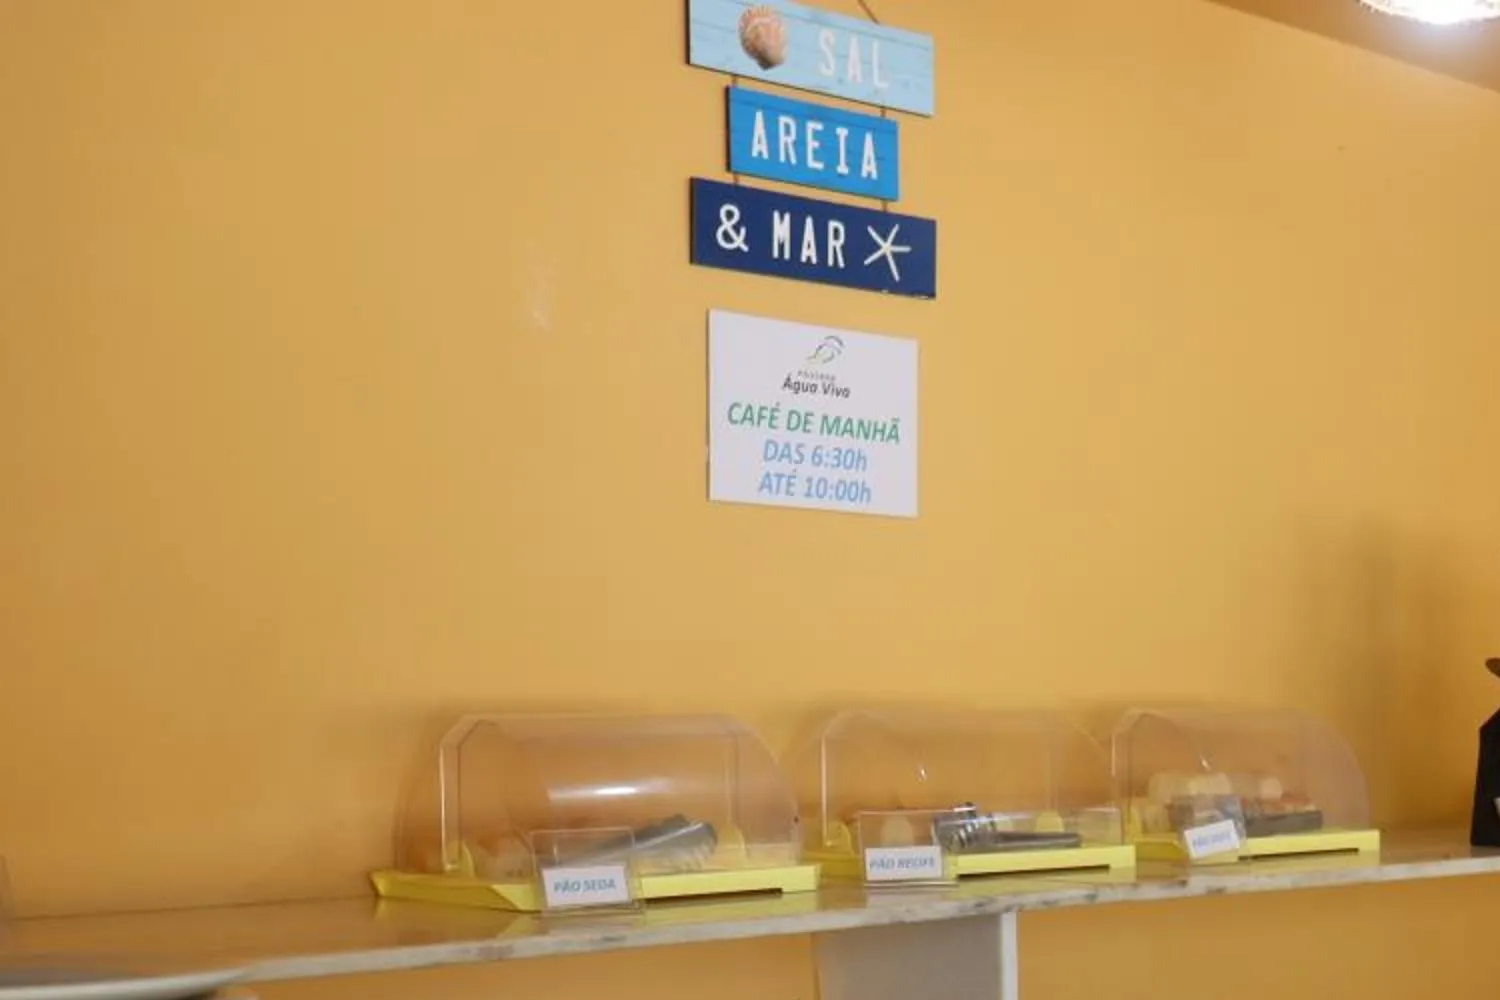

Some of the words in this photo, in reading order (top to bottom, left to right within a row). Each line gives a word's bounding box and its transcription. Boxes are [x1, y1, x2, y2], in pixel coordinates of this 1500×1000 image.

[819, 29, 889, 89] SAL
[751, 109, 878, 180] AREIA
[716, 203, 749, 252] &
[772, 209, 846, 269] MAR
[781, 372, 818, 395] Água
[822, 381, 851, 399] Viva
[727, 401, 781, 430] CAFÉ
[786, 409, 815, 434] DE
[820, 414, 901, 443] MANHÃ
[763, 439, 805, 465] DAS
[811, 445, 868, 473] 6:30h
[758, 468, 797, 497] ATÉ
[803, 476, 872, 505] 10:00h
